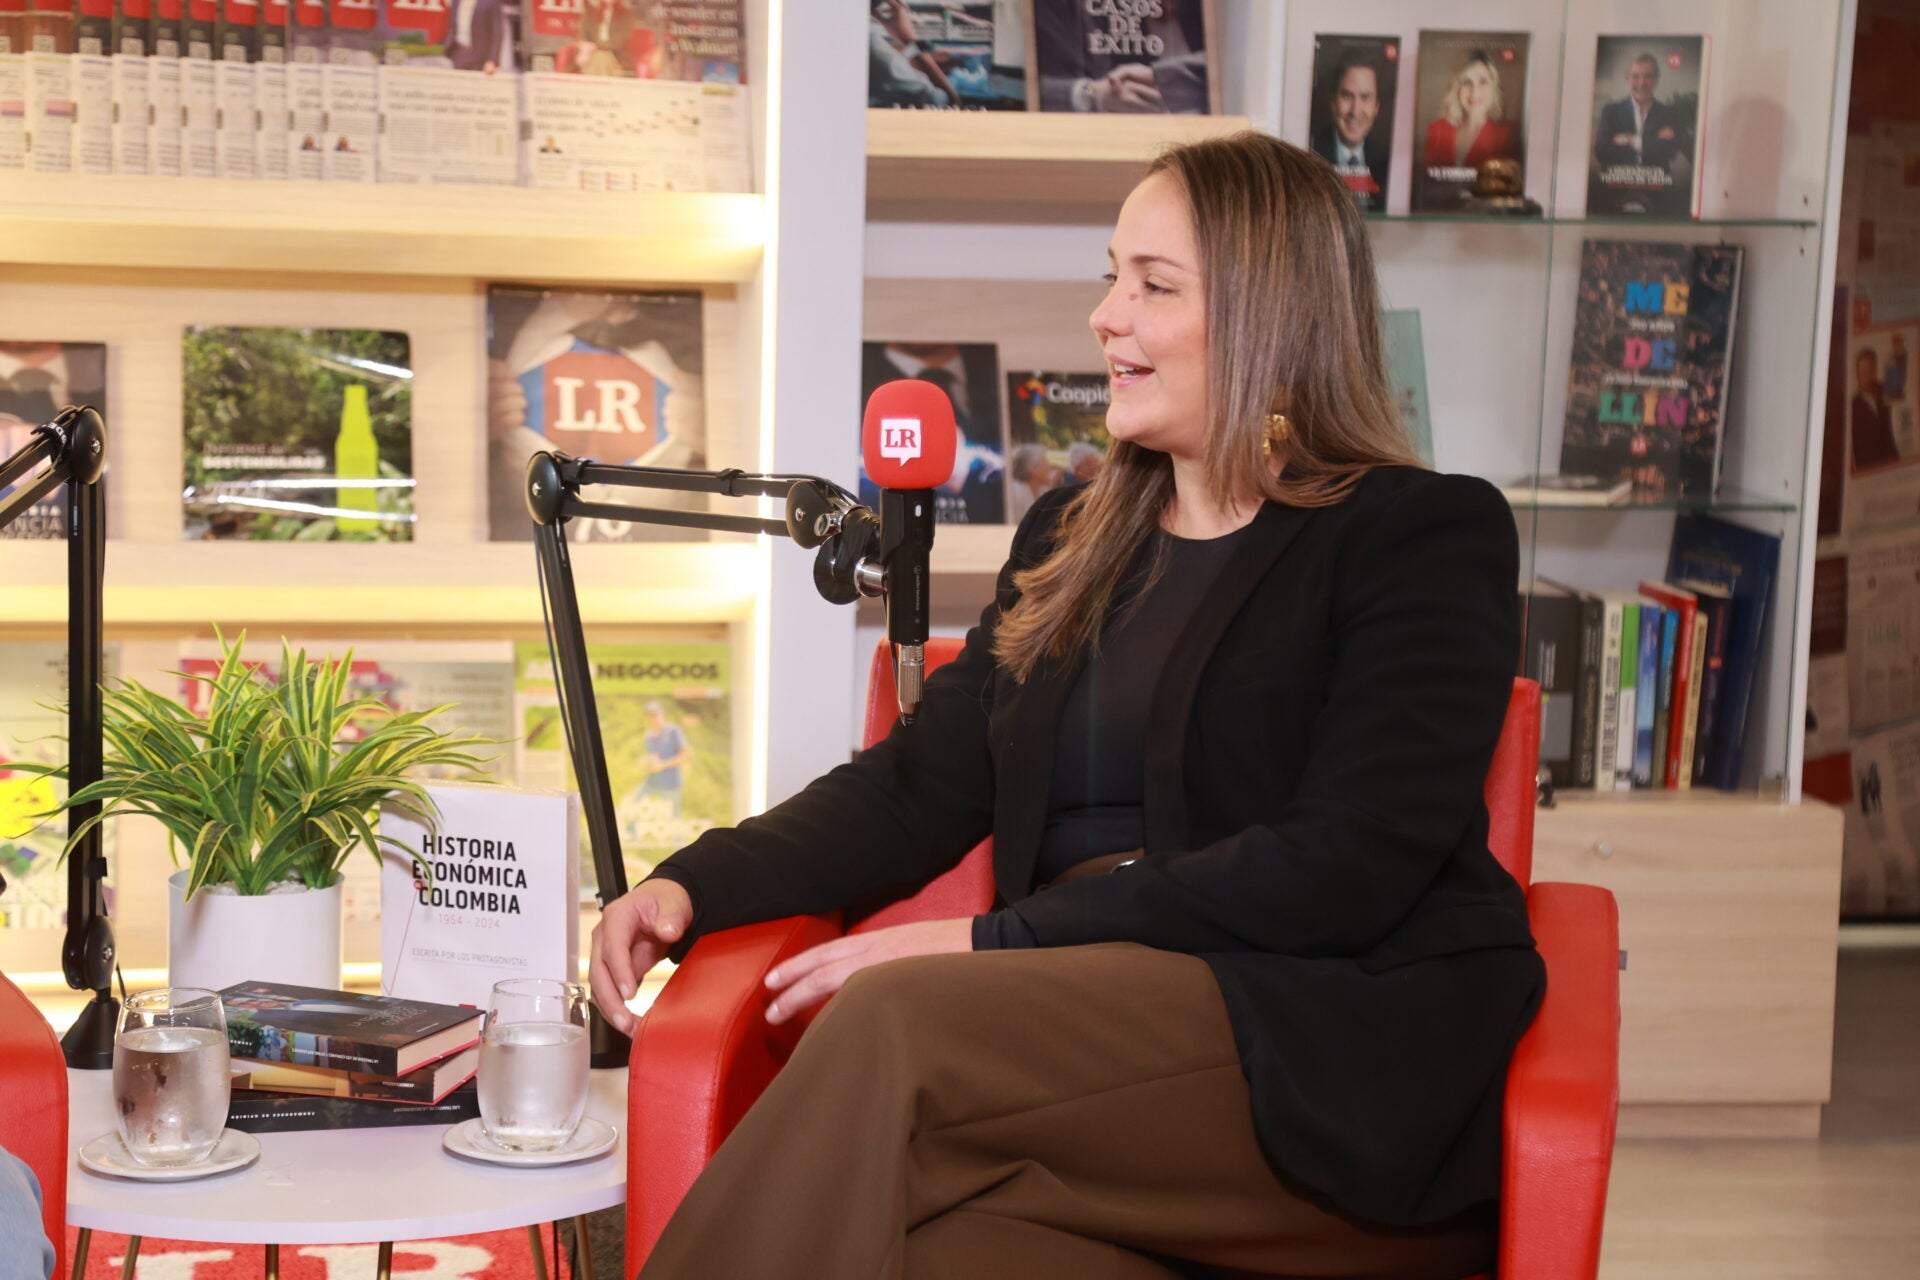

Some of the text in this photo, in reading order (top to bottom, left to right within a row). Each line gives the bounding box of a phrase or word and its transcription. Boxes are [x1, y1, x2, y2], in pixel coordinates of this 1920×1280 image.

[1086, 0, 1164, 18] CASOS
[1109, 14, 1141, 34] DE
[1624, 280, 1690, 315] ME
[1622, 336, 1677, 371] DE
[552, 376, 646, 433] LR
[884, 428, 917, 448] LR
[422, 834, 517, 862] HISTORIA
[412, 858, 528, 889] ECONÓMICA
[418, 887, 521, 915] COLOMBIA
